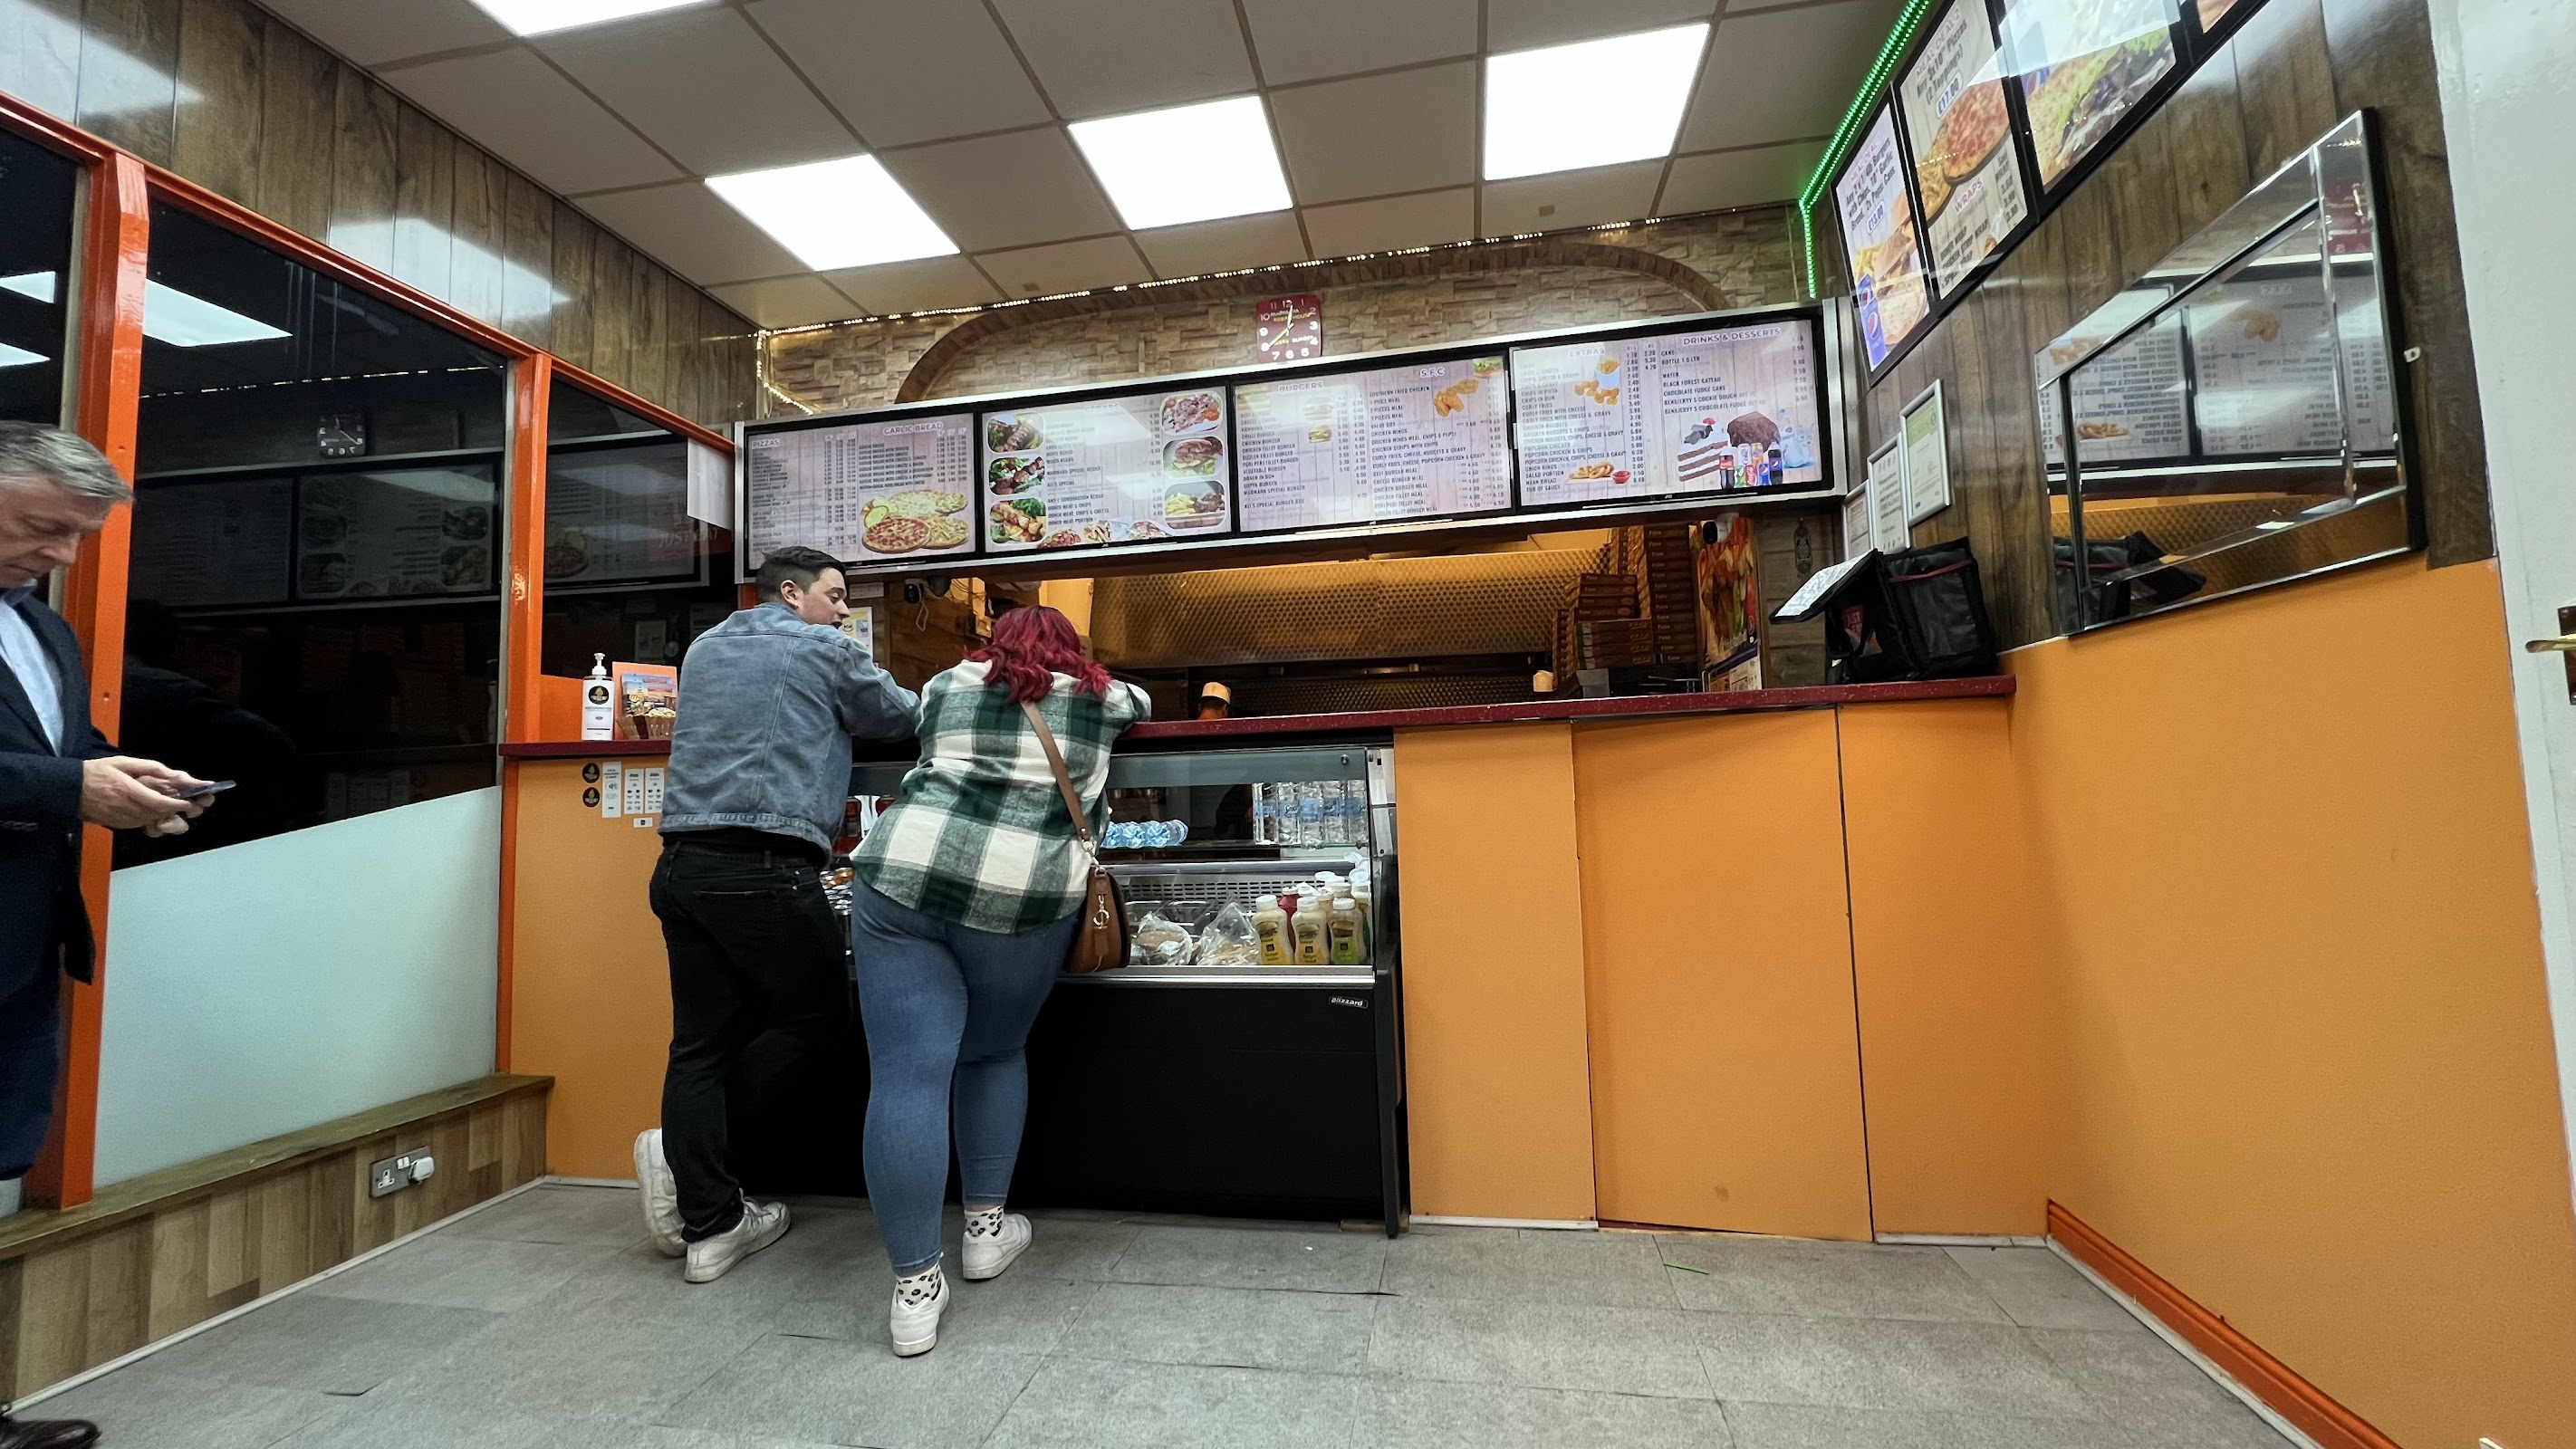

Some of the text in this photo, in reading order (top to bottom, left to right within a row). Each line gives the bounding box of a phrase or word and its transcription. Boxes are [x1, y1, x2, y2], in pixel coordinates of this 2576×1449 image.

[1916, 6, 1960, 80] MEAL DEAL 2
[1937, 76, 1959, 115] £17.00
[1955, 176, 1982, 214] WRAPS
[1260, 312, 1270, 321] 10
[1309, 321, 1319, 330] 3
[1259, 327, 1268, 337] 9
[1683, 334, 1719, 345] DRINKS
[1730, 327, 1780, 340] DESSERTS
[1310, 337, 1319, 345] 4
[1272, 351, 1280, 360] 7
[1285, 350, 1294, 359] 6
[1301, 348, 1309, 357] 5
[1570, 347, 1604, 357] EXTRAS
[1279, 380, 1322, 392] BURGERS
[1663, 388, 1692, 396] CHOCOLATE
[884, 422, 942, 435] GARLIC BREAD
[752, 438, 779, 447] PIZZAS
